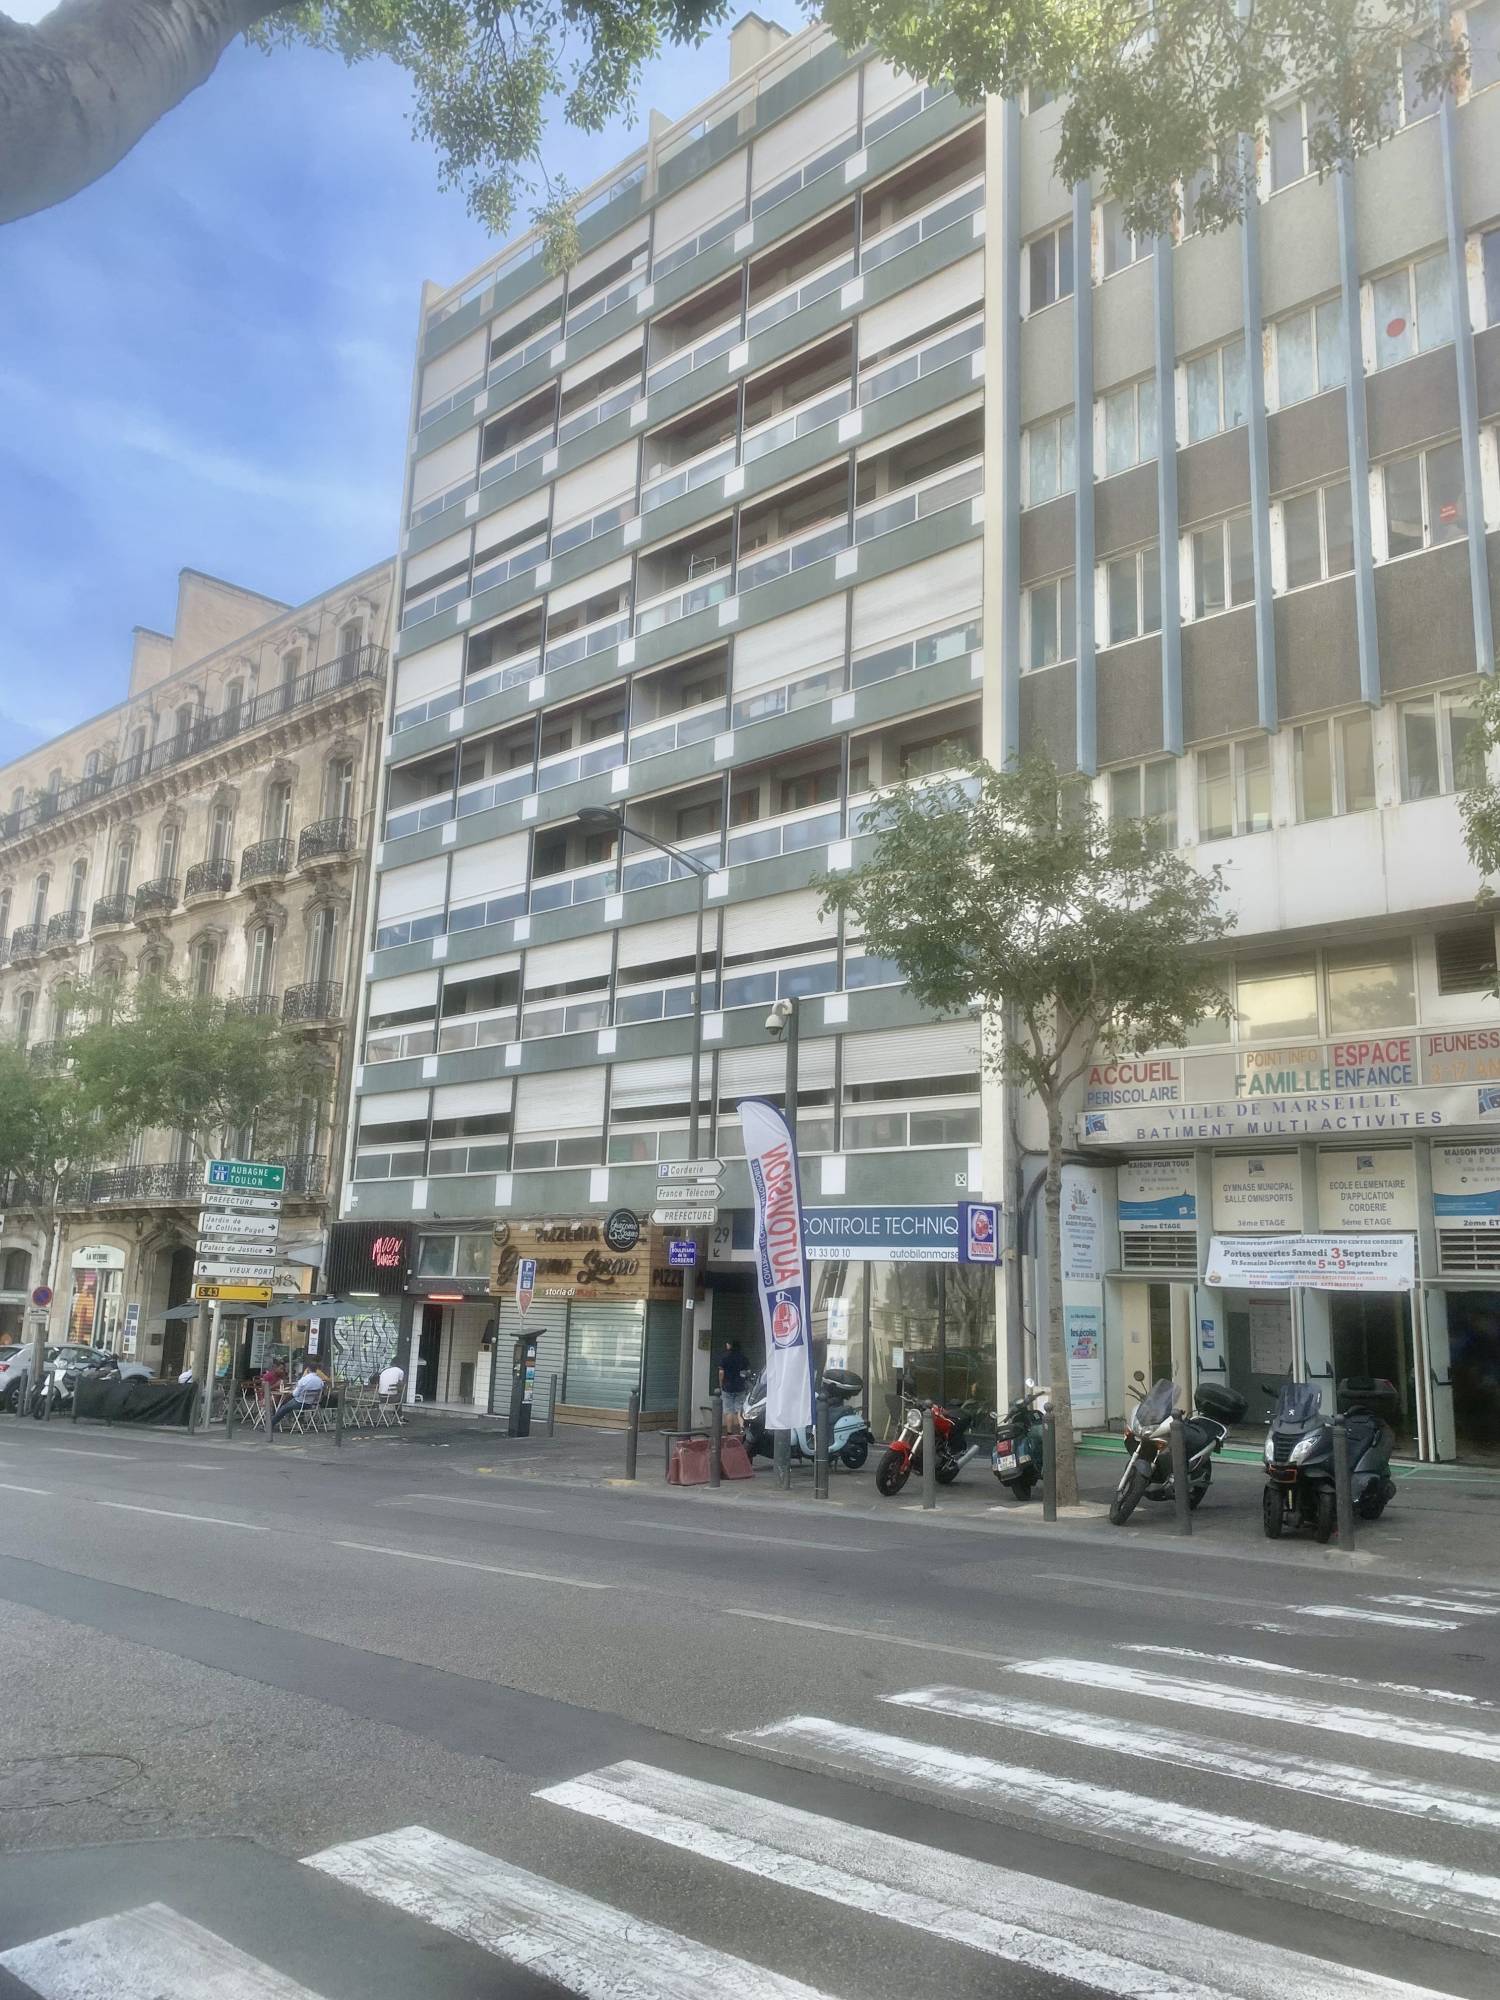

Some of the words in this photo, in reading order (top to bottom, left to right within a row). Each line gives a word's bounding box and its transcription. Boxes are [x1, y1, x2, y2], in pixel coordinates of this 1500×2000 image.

[1246, 1052, 1284, 1069] POINT
[1288, 1048, 1319, 1065] INFO
[1333, 1040, 1411, 1067] ESPACE
[1088, 1061, 1179, 1086] ACCUEIL
[1335, 1064, 1413, 1089] ENFANCE
[1235, 1068, 1331, 1098] FAMILLE
[1087, 1085, 1179, 1106] PERISCOLAIRE
[1168, 1104, 1226, 1121] VILLE
[1237, 1102, 1262, 1117] DE
[1271, 1094, 1401, 1114] MARSEILLE
[1136, 1123, 1235, 1140] BATIMENT
[1247, 1119, 1309, 1135] MULTI
[1320, 1110, 1443, 1131] ACTIVITES
[1444, 1148, 1477, 1156] MAISON
[1153, 1160, 1171, 1168] POUR
[1172, 1160, 1190, 1168] TOUS
[231, 1166, 269, 1177] AUBAGNE
[670, 1165, 704, 1175] Corderie
[230, 1175, 263, 1186] TOULON
[1329, 1181, 1353, 1190] ECOLE
[1354, 1179, 1407, 1189] ELEMENTAIRE
[658, 1187, 683, 1198] France
[1222, 1183, 1256, 1192] GYMNASE
[1257, 1182, 1294, 1191] MUNICIPAL
[1224, 1194, 1247, 1203] SALLE
[1247, 1193, 1294, 1203] OMNISPORTS
[1340, 1191, 1395, 1201] D'APPLICATION
[1348, 1202, 1388, 1212] CORDERIE
[206, 1216, 230, 1224] Jardin
[1363, 1217, 1392, 1226] ETAGE
[215, 1224, 241, 1232] Colline
[244, 1226, 265, 1234] Puget
[884, 1215, 959, 1237] TECHNIQ
[714, 1227, 730, 1243] 29
[203, 1243, 225, 1251] Palais
[237, 1245, 263, 1254] Justice
[372, 1236, 403, 1260] MOON
[808, 1248, 817, 1258] 91
[818, 1247, 828, 1258] 33
[829, 1247, 840, 1258] 00
[842, 1247, 851, 1258] 10
[1223, 1249, 1251, 1257] Portes
[1252, 1250, 1290, 1258] ouvertes
[1291, 1248, 1328, 1257] Samedi
[1331, 1247, 1341, 1259] 3
[1342, 1249, 1398, 1258] Septembre
[1318, 1259, 1326, 1269] 5
[1338, 1259, 1346, 1270] 9
[1346, 1259, 1388, 1267] Septembre
[207, 1287, 219, 1296] 43
[545, 1288, 567, 1297] storia
[567, 1287, 576, 1296] di
